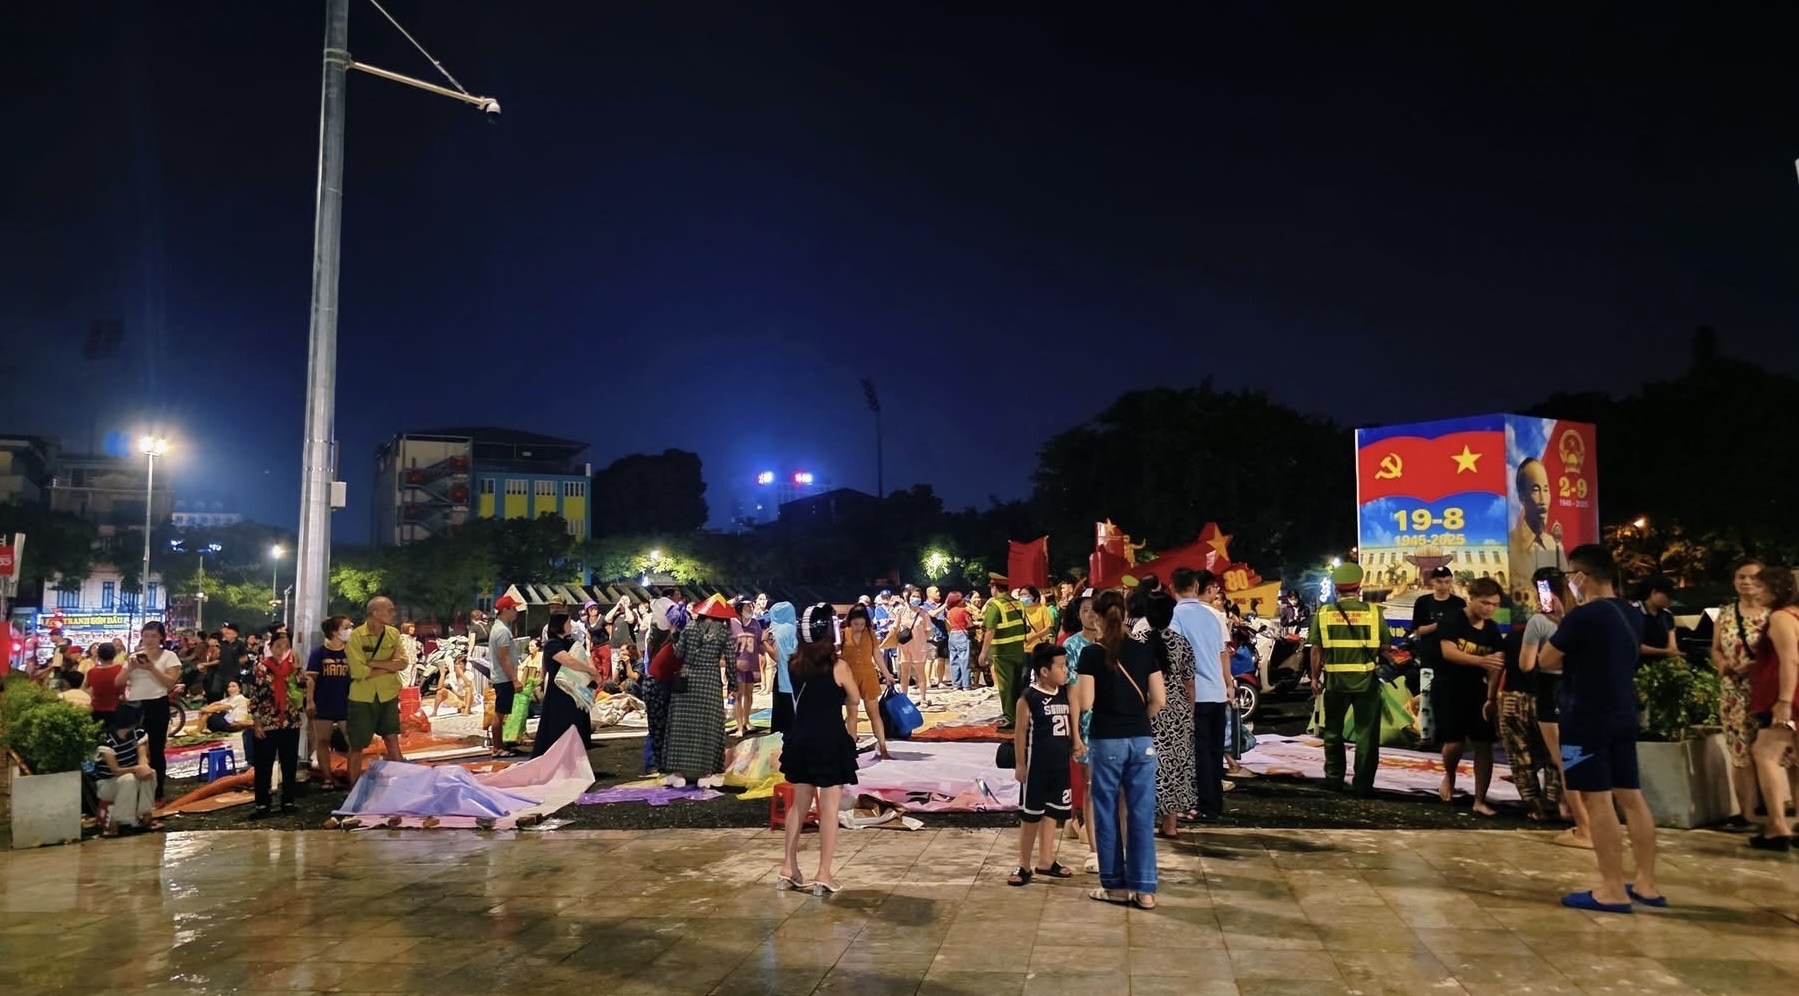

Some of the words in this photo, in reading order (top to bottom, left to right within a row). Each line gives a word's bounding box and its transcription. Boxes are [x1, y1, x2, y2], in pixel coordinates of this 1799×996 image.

[1559, 476, 1588, 499] 2-9
[1393, 507, 1465, 532] 19-8
[1394, 533, 1466, 547] 1945-2025
[1223, 569, 1249, 592] 80
[1052, 714, 1070, 736] 21
